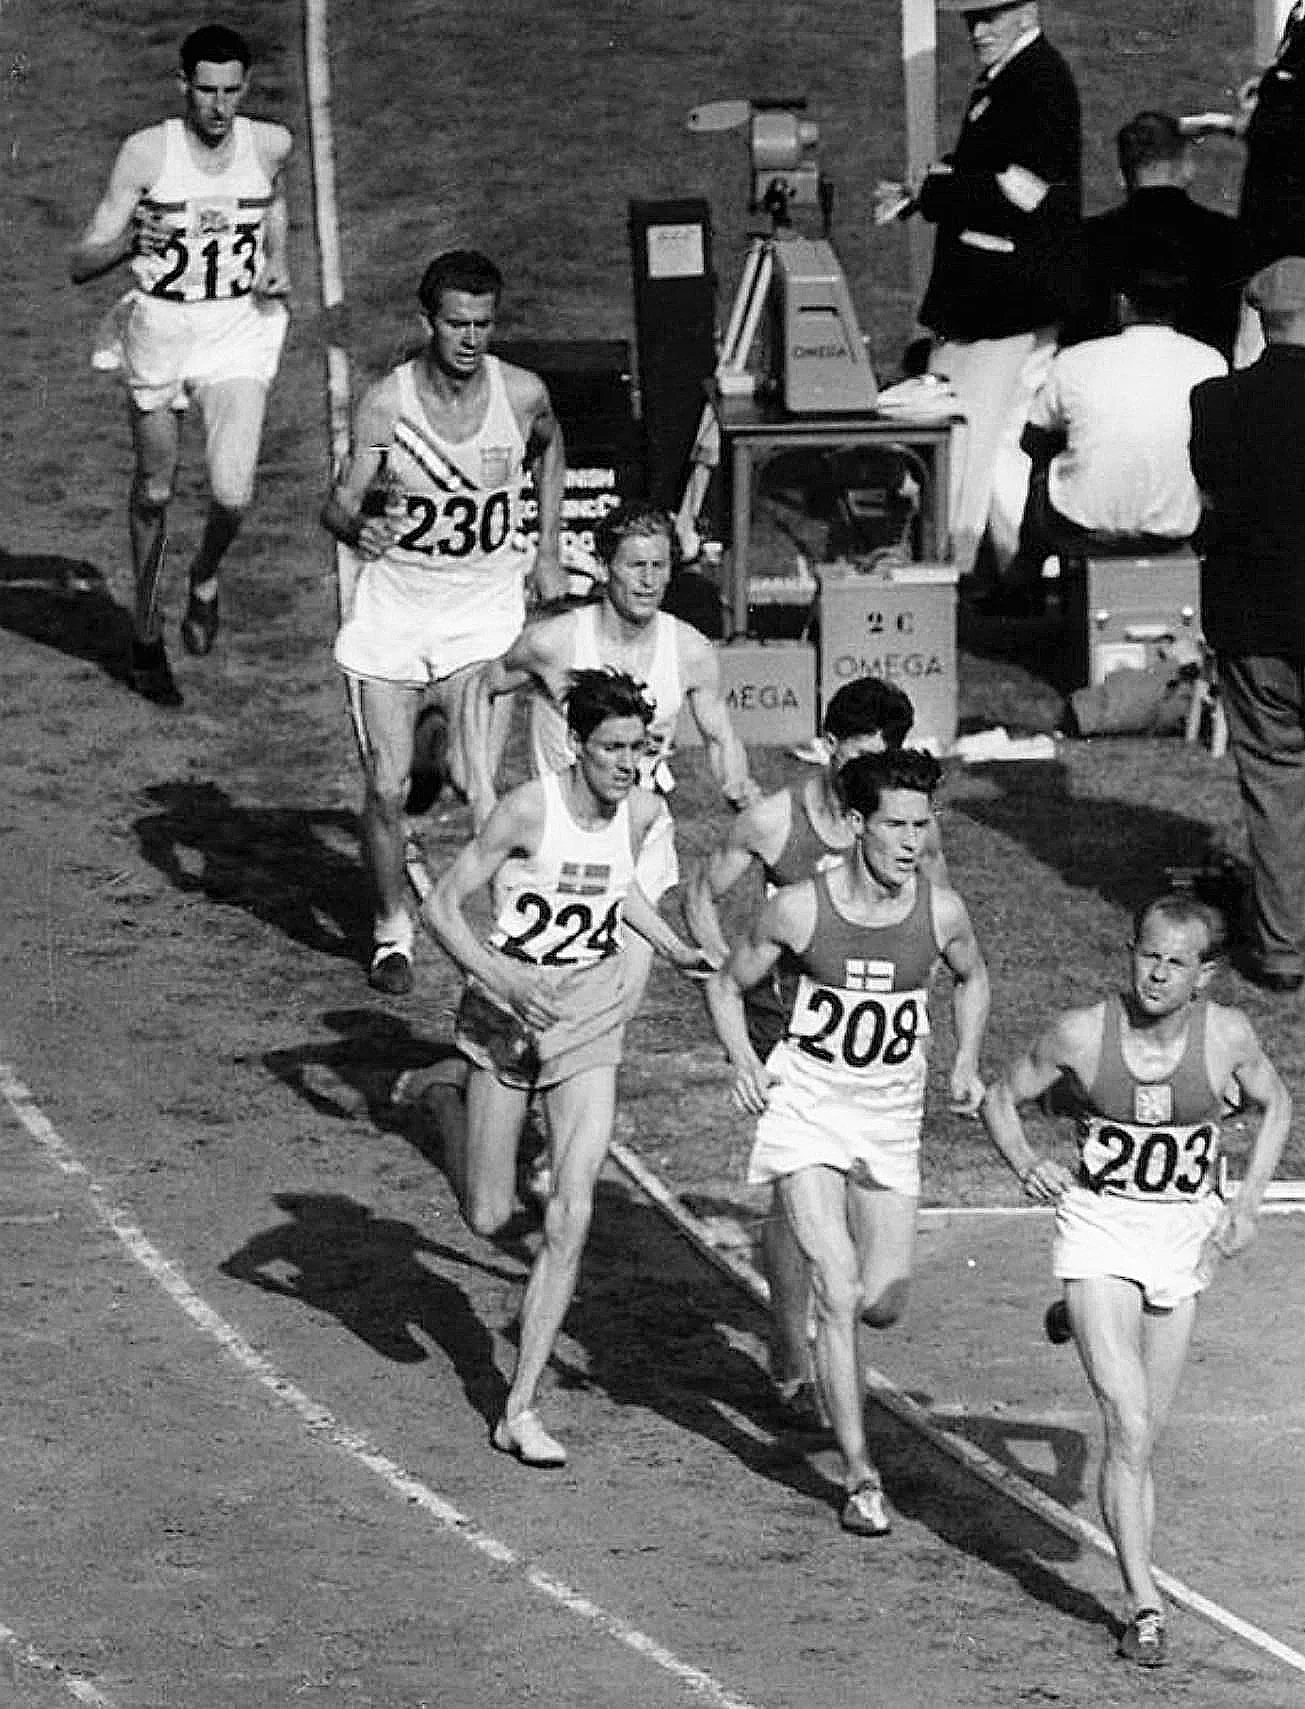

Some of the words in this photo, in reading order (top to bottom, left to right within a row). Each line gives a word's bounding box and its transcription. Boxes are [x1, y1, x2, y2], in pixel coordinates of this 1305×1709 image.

[152, 233, 257, 303] 213
[792, 345, 847, 359] OMEGA
[400, 492, 510, 557] 230
[724, 684, 799, 711] MEGA
[832, 654, 944, 678] OMEGA
[500, 892, 620, 966] 224
[798, 989, 918, 1068] 208
[1088, 1125, 1213, 1195] 203
